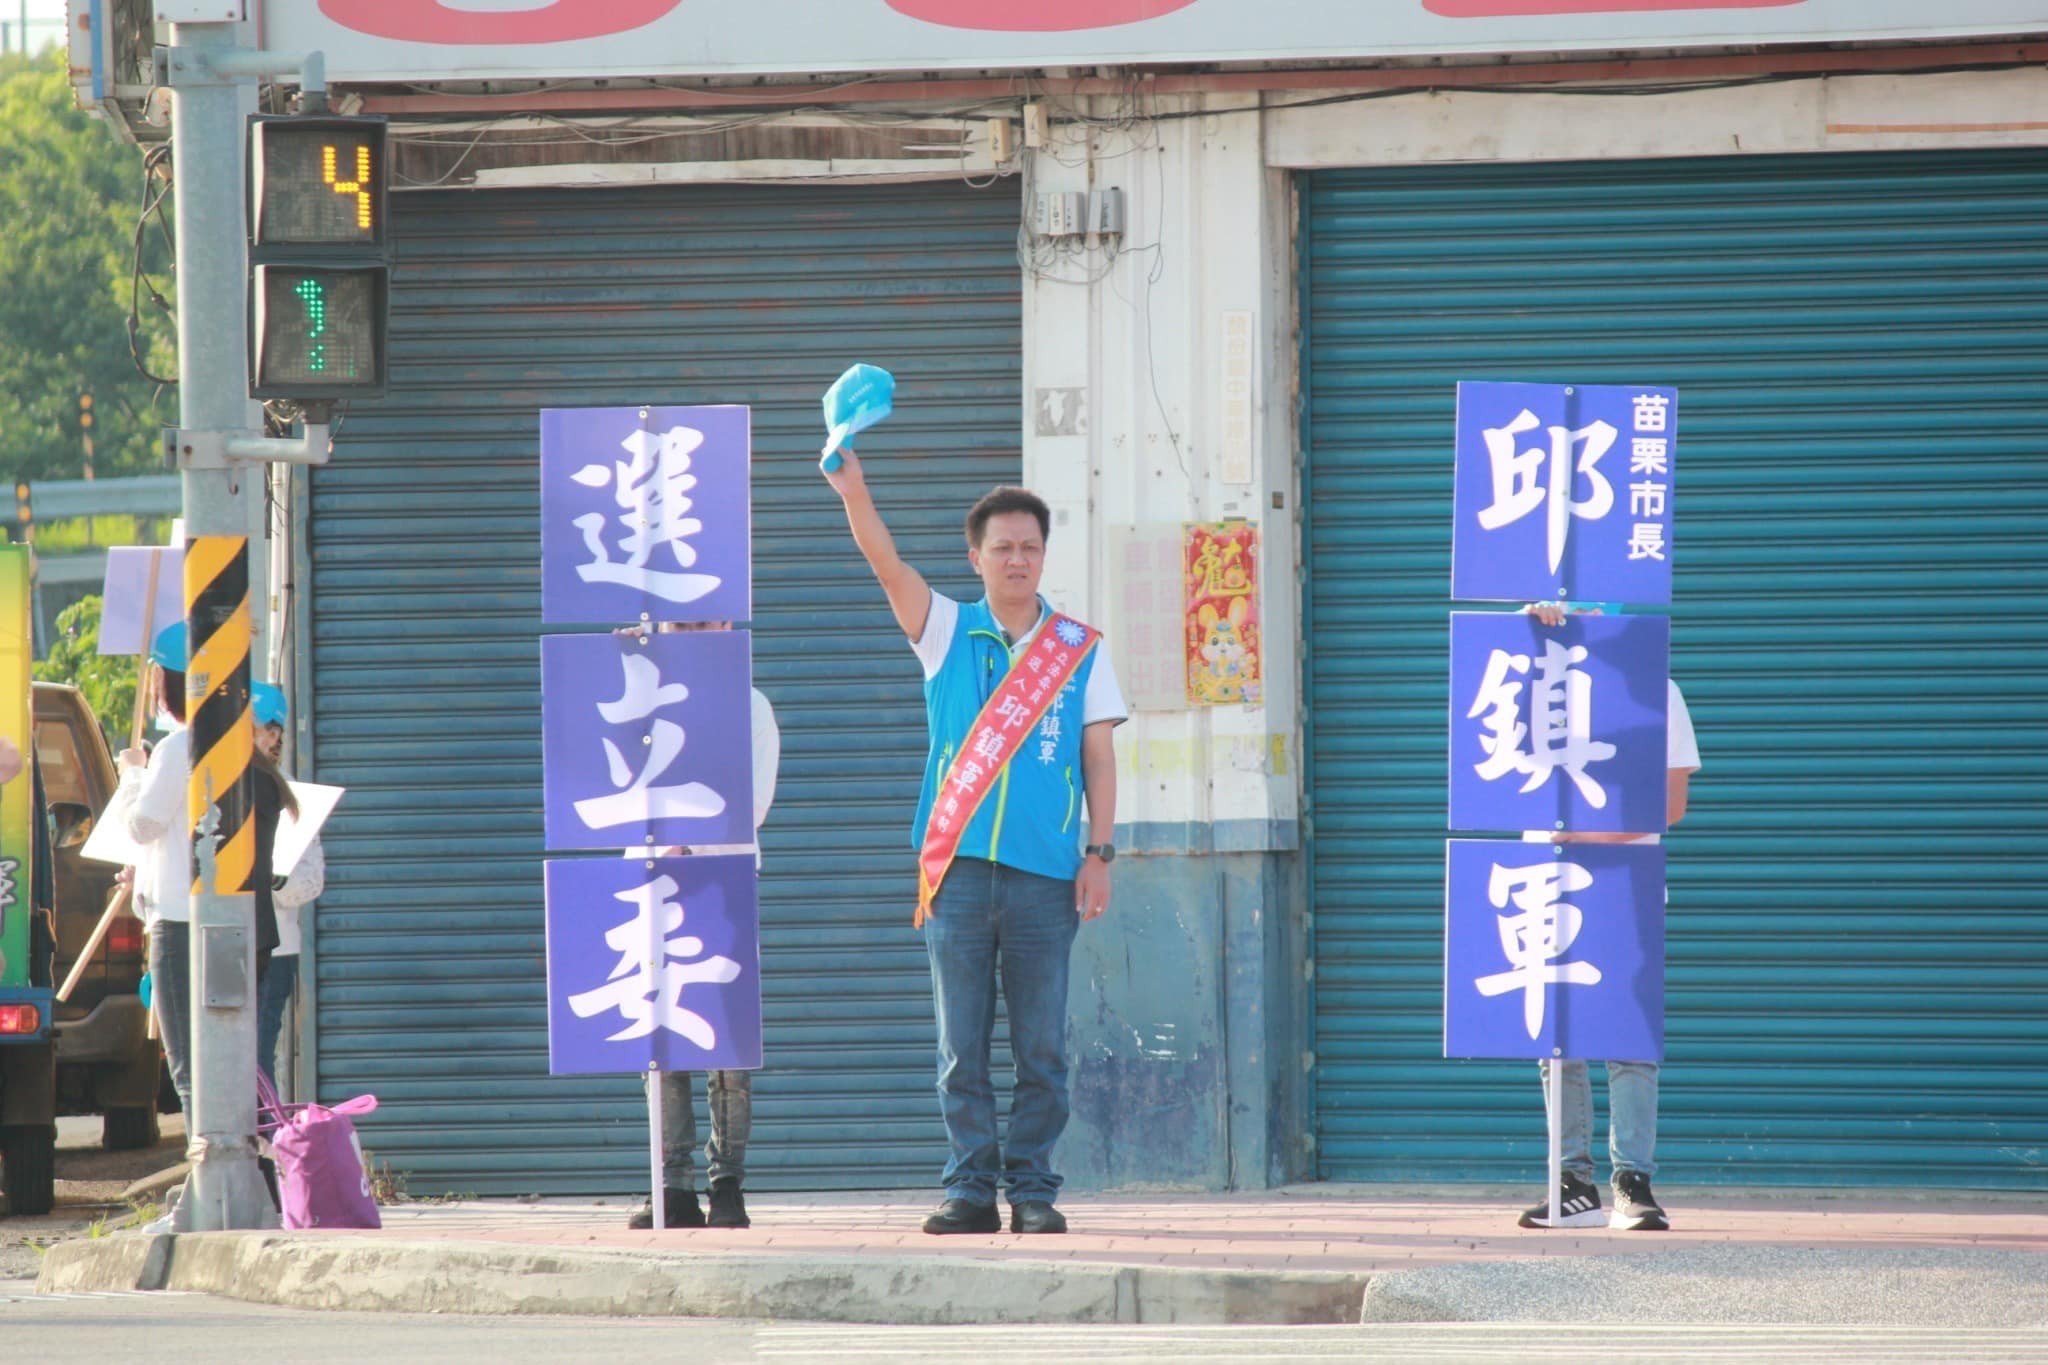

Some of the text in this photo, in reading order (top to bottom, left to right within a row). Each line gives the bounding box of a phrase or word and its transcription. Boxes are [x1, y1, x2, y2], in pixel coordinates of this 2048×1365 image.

[322, 146, 371, 228] 4
[1628, 394, 1668, 561] 苗栗市長
[568, 428, 741, 1051] 選立委
[952, 694, 1031, 795] 邱鎮軍
[1466, 408, 1618, 1041] 邱鎮軍
